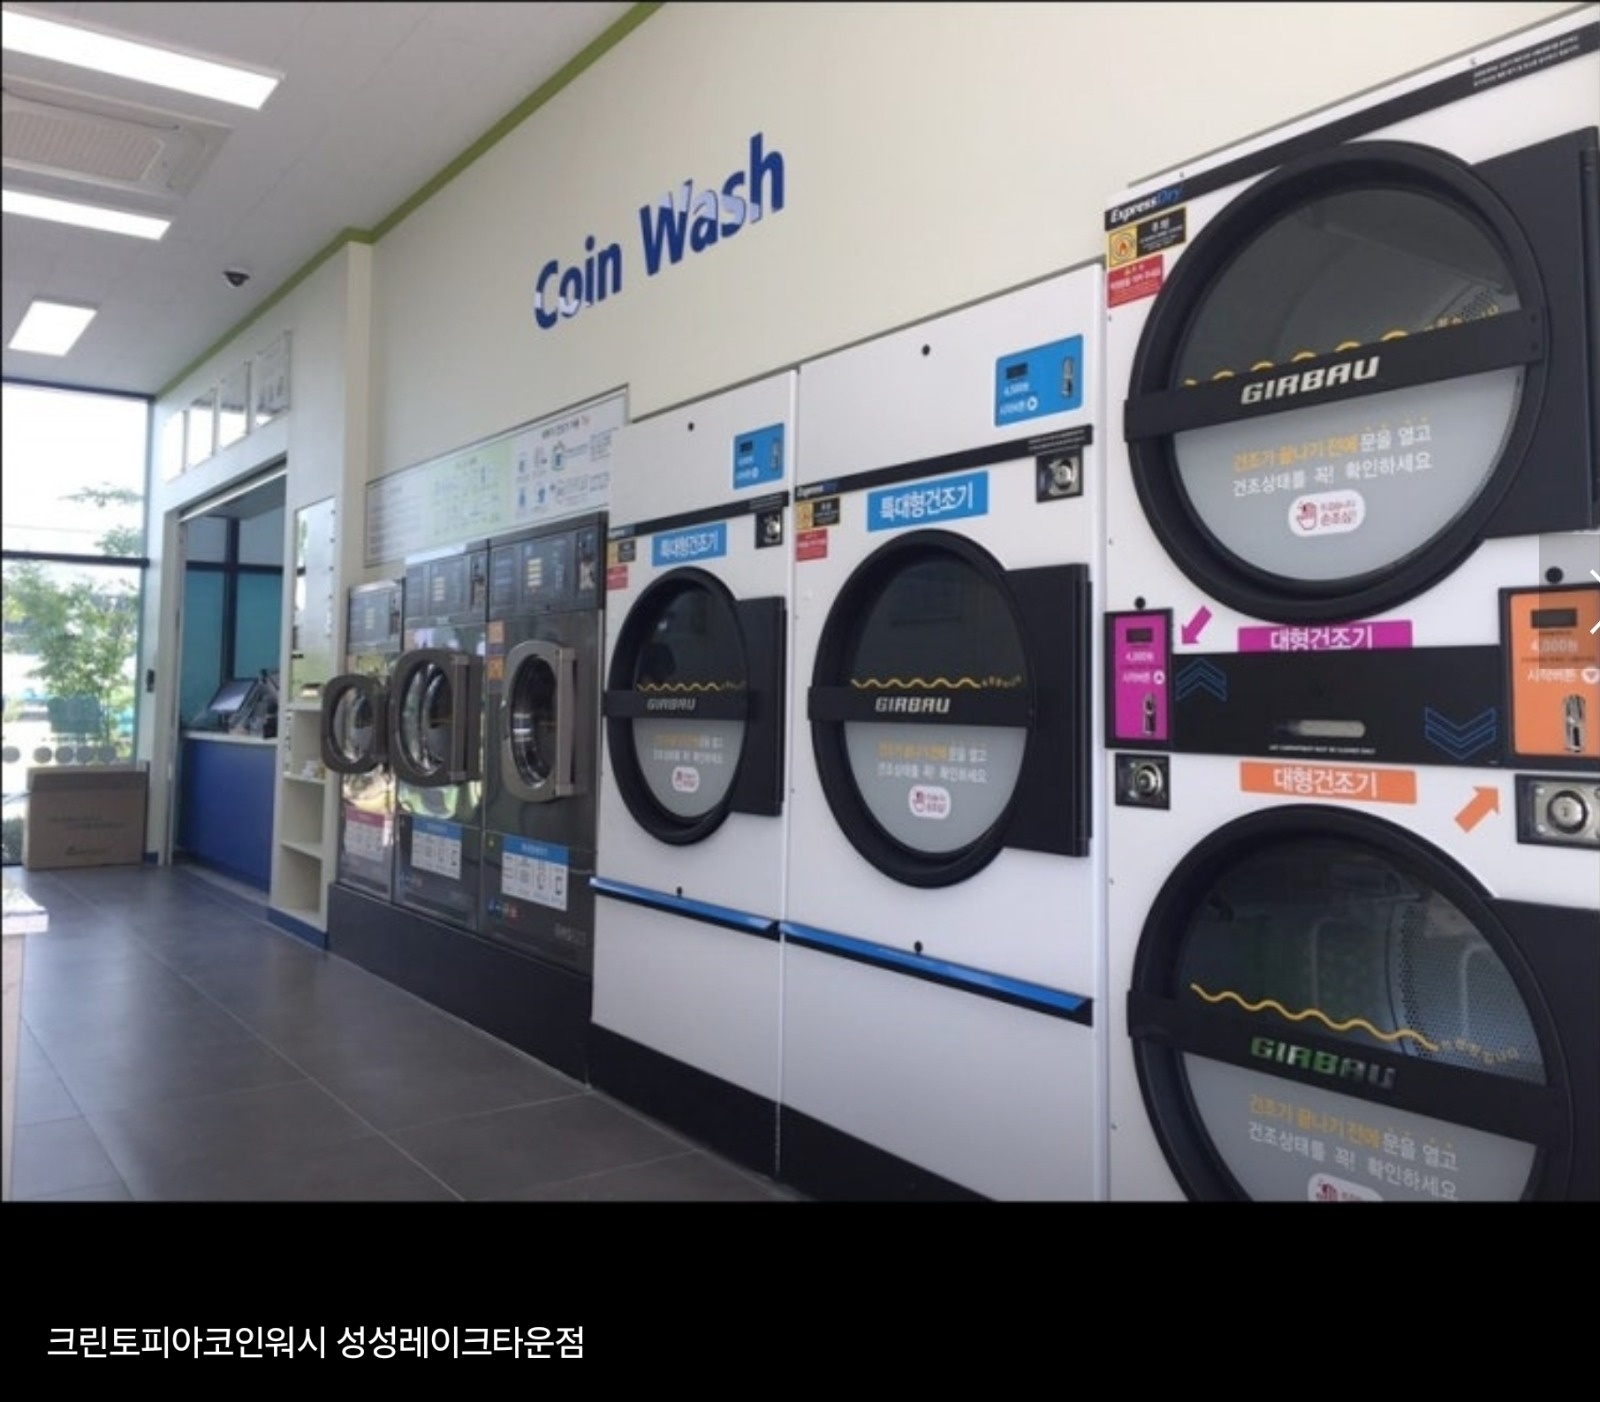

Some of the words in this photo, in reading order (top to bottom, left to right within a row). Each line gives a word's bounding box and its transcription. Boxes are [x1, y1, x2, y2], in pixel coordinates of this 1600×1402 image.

[533, 233, 622, 330] Coin
[639, 132, 785, 277] Wash
[1240, 355, 1380, 405] GIRBAU
[1345, 452, 1434, 480] 확인하세요
[879, 481, 974, 521] 특대형건조기
[874, 696, 951, 714] GIRBAU
[1272, 765, 1378, 799] 대형건조기
[1250, 1036, 1395, 1089] GIRBAU
[1367, 1155, 1459, 1200] 확인하세요
